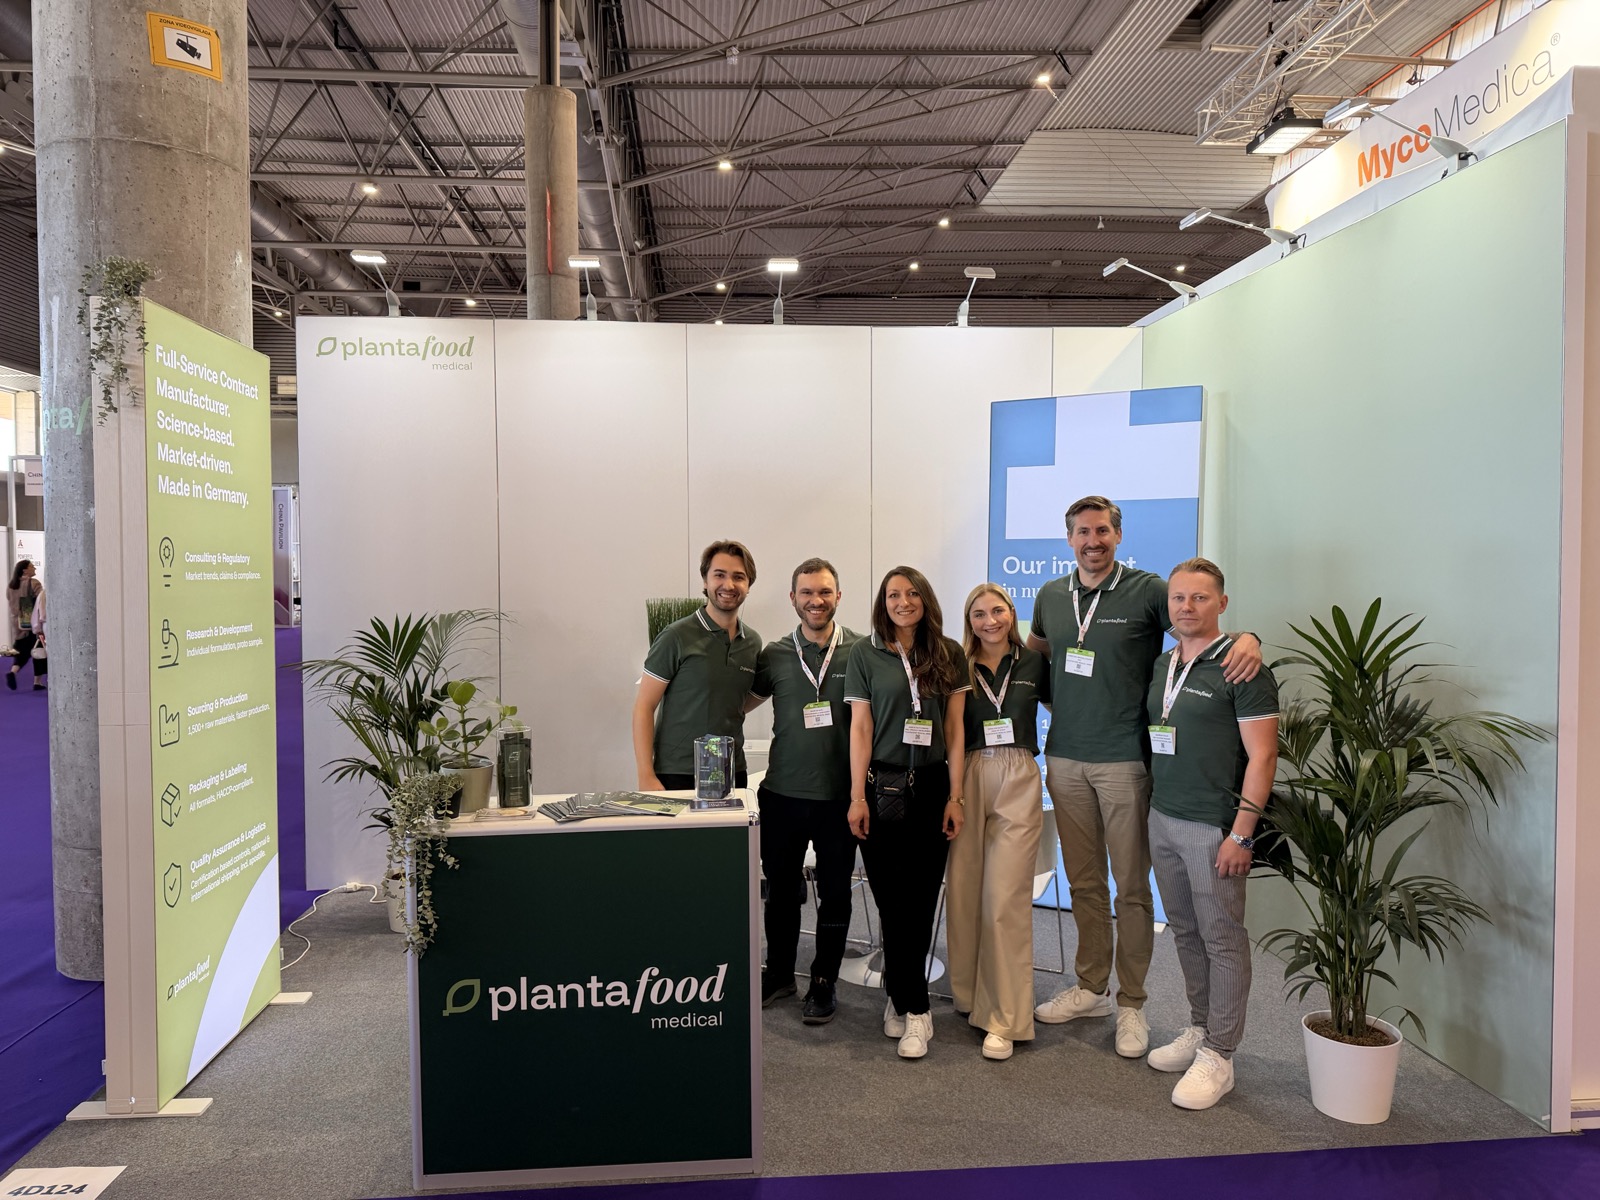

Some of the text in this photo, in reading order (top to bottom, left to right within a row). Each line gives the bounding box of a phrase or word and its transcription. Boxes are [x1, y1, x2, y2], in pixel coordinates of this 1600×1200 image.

[159, 18, 211, 36] ZONA VIDEOVIGILADA
[341, 335, 474, 361] plantafood
[155, 344, 259, 400] Full-Service Contract
[432, 361, 473, 371] medical
[156, 376, 231, 418] Manufacturer.
[156, 409, 235, 447] Science-based.
[157, 442, 233, 475] Market-driven.
[158, 474, 249, 509] Made in Germany.
[185, 551, 250, 565] Consulting & Regulatory
[1002, 556, 1046, 575] Our
[185, 572, 203, 581] Market
[220, 571, 234, 580] claims
[233, 571, 238, 580] &
[186, 623, 253, 640] Research & Development
[186, 645, 210, 657] Individual
[187, 692, 248, 717] Sourcing & Production
[204, 720, 214, 729] raw
[189, 763, 248, 795] Packaging & Labeling
[190, 822, 266, 873] Quality Assurance & Logistics
[488, 962, 728, 1021] plantafood
[650, 1011, 723, 1029] medical
[7, 1183, 88, 1197] 4D124
